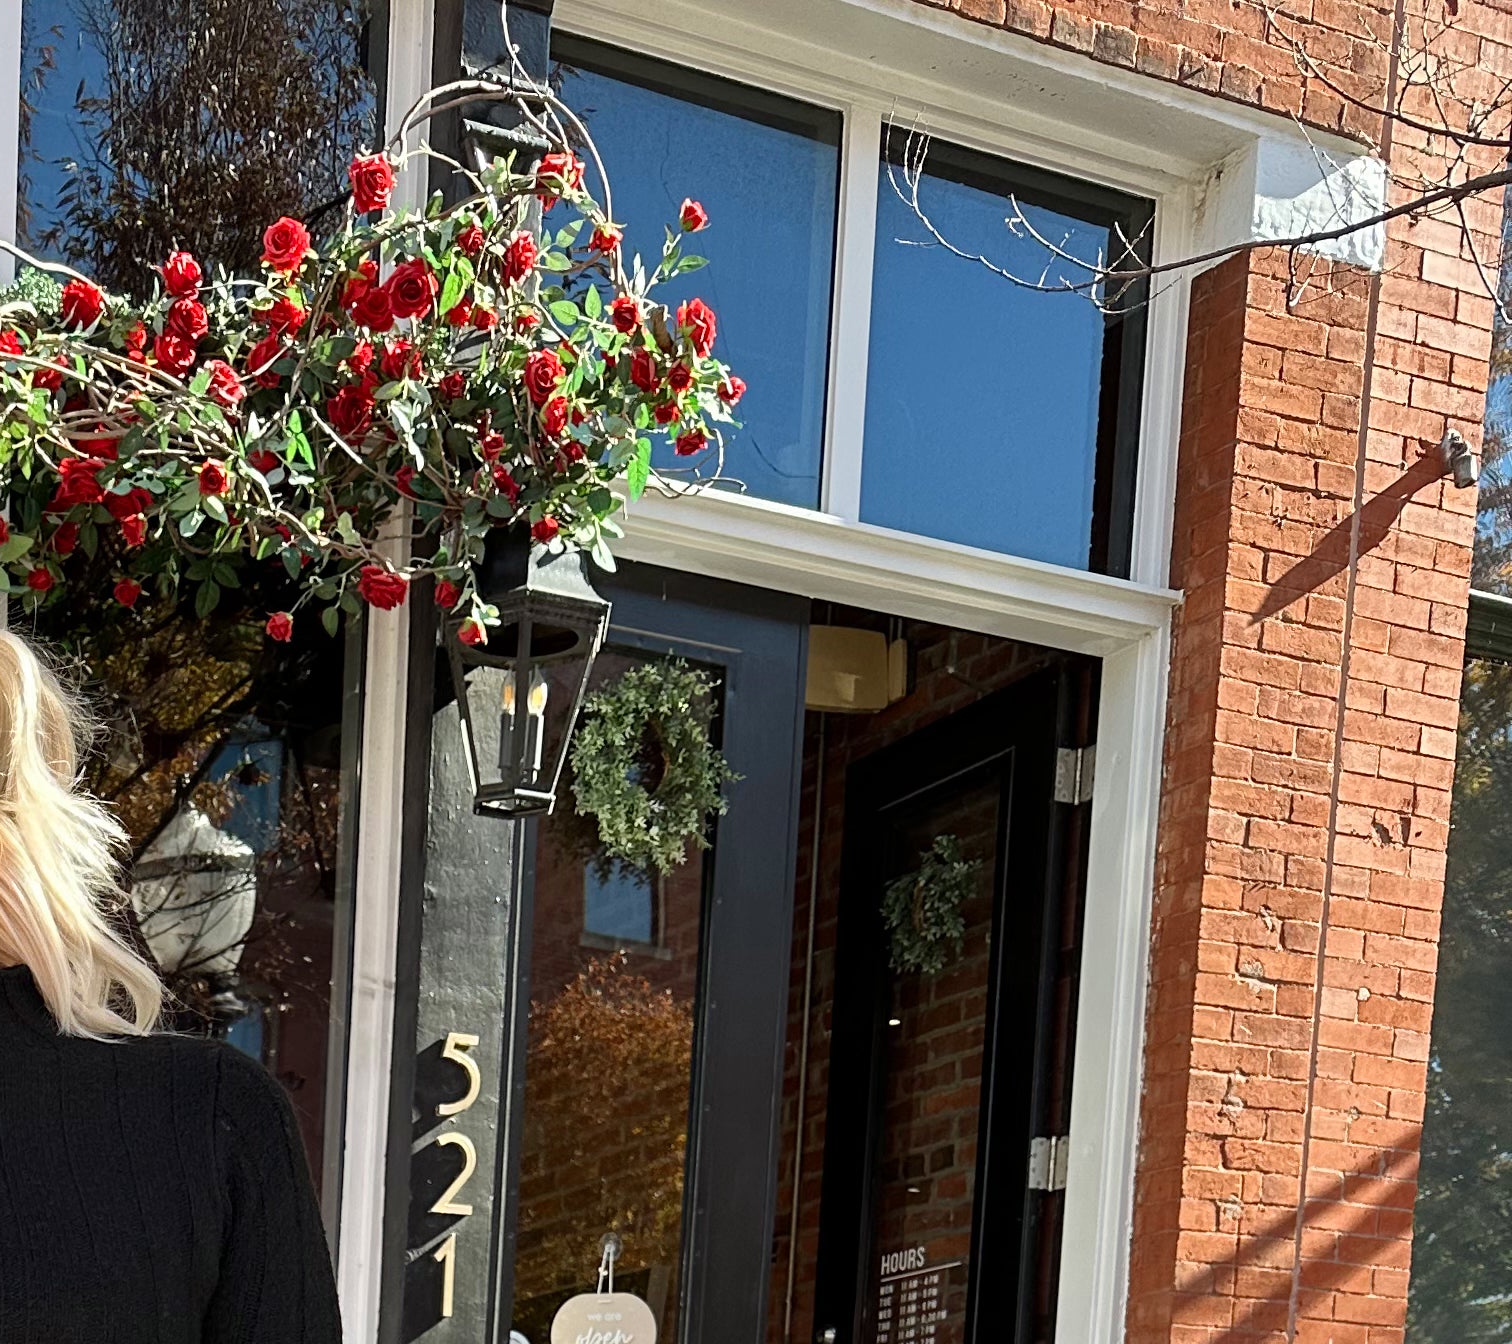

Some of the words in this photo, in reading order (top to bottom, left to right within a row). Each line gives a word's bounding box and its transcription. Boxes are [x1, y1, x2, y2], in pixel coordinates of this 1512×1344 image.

[429, 1032, 481, 1319] 521
[881, 1246, 925, 1276] HOURS
[587, 1312, 602, 1321] we
[604, 1312, 622, 1321] are
